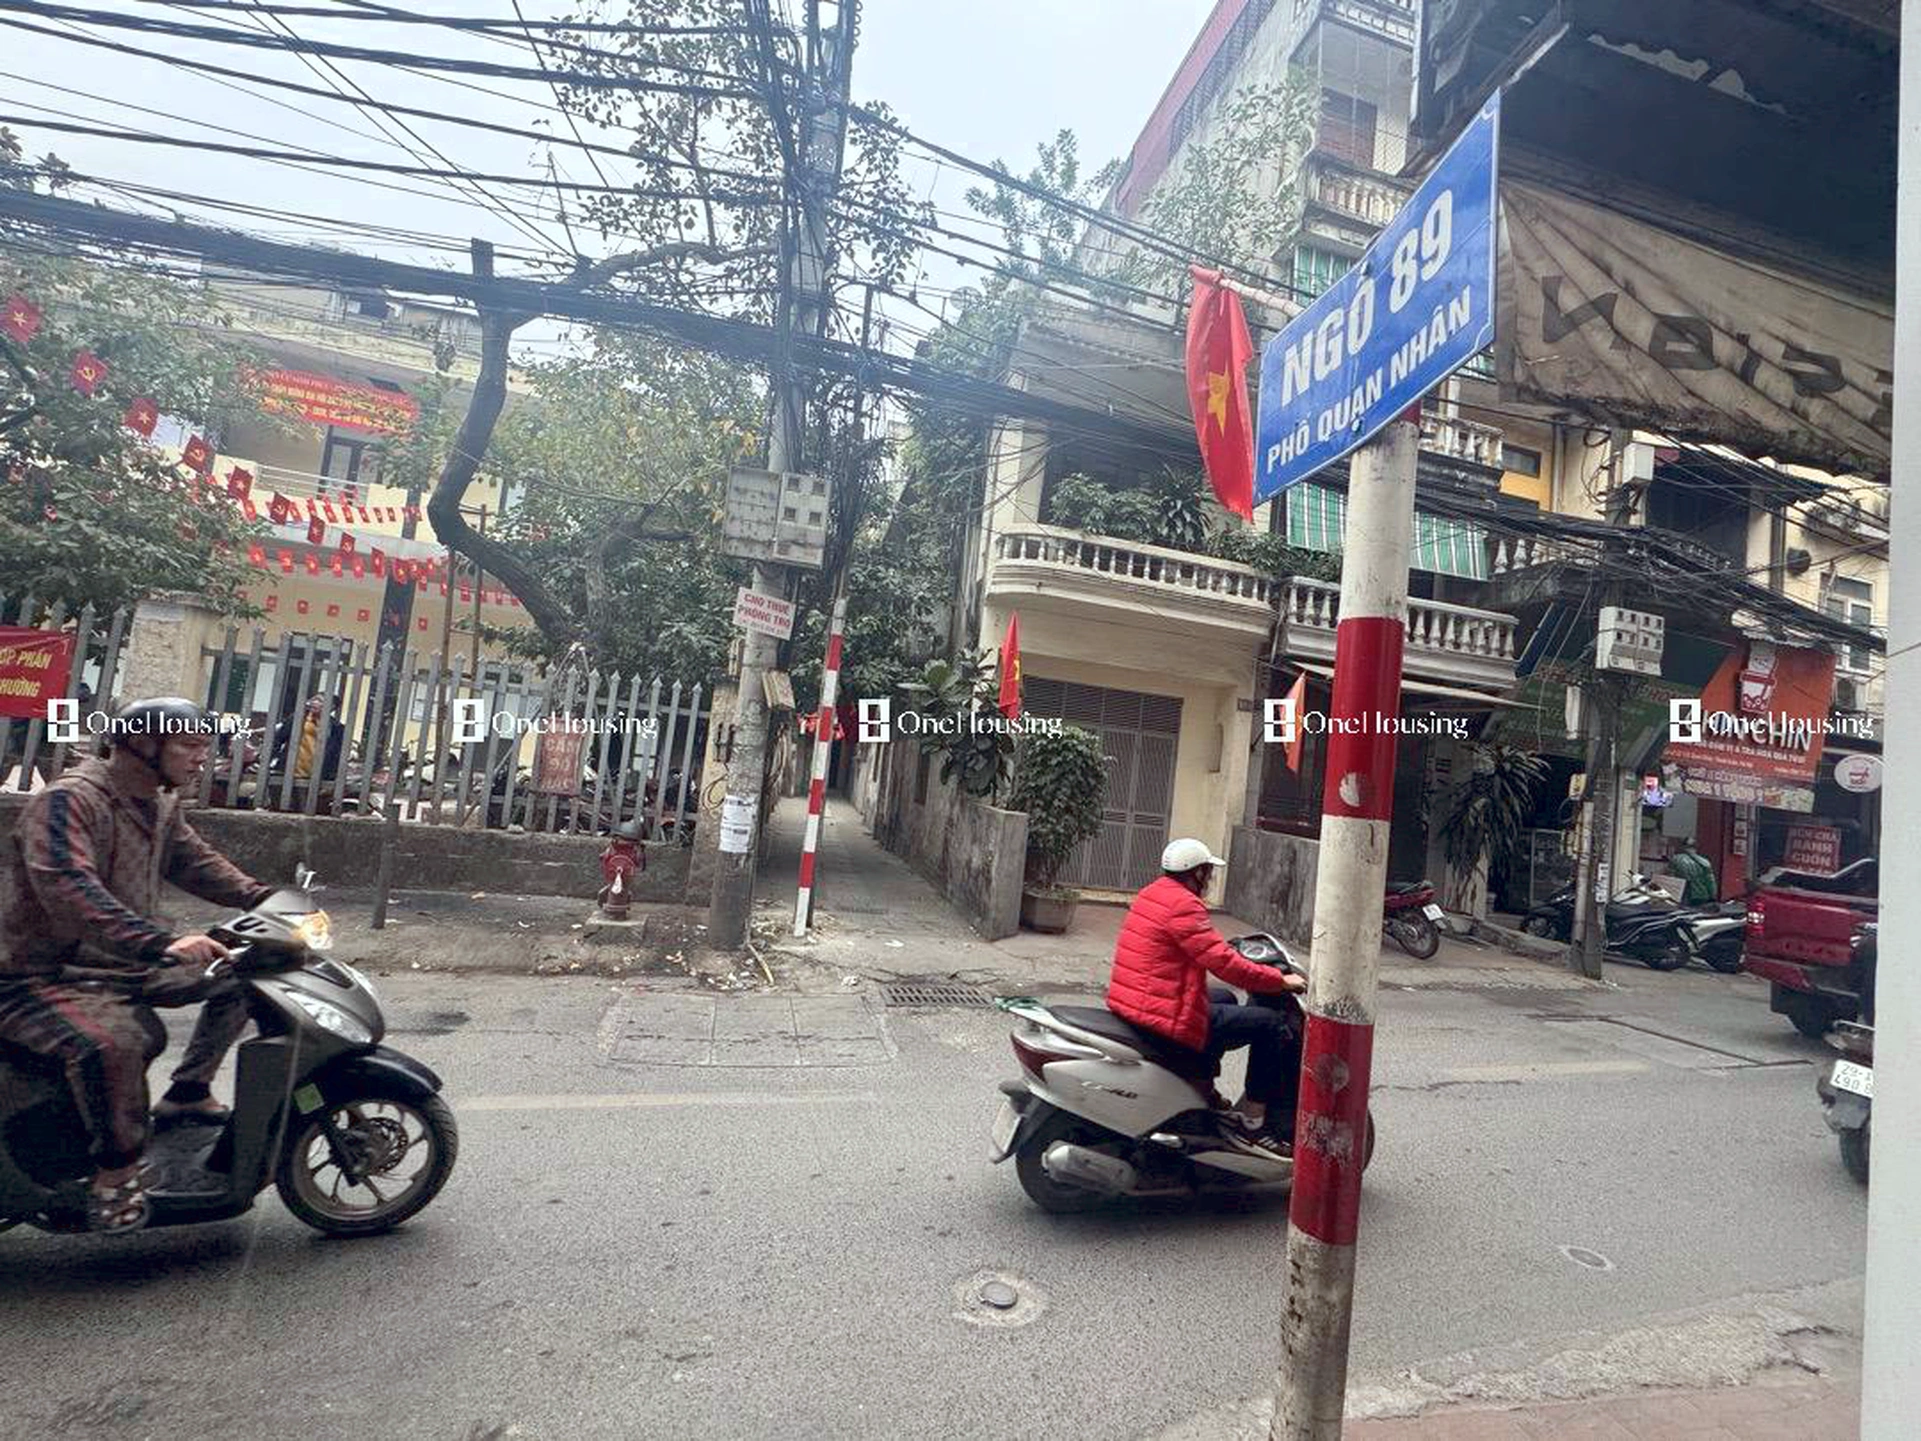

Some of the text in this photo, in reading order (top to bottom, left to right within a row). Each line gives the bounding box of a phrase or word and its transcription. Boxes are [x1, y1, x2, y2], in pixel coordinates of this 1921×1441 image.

[1389, 189, 1453, 314] 89
[1266, 411, 1311, 474] PHỐ
[1390, 285, 1471, 388] NHÂN
